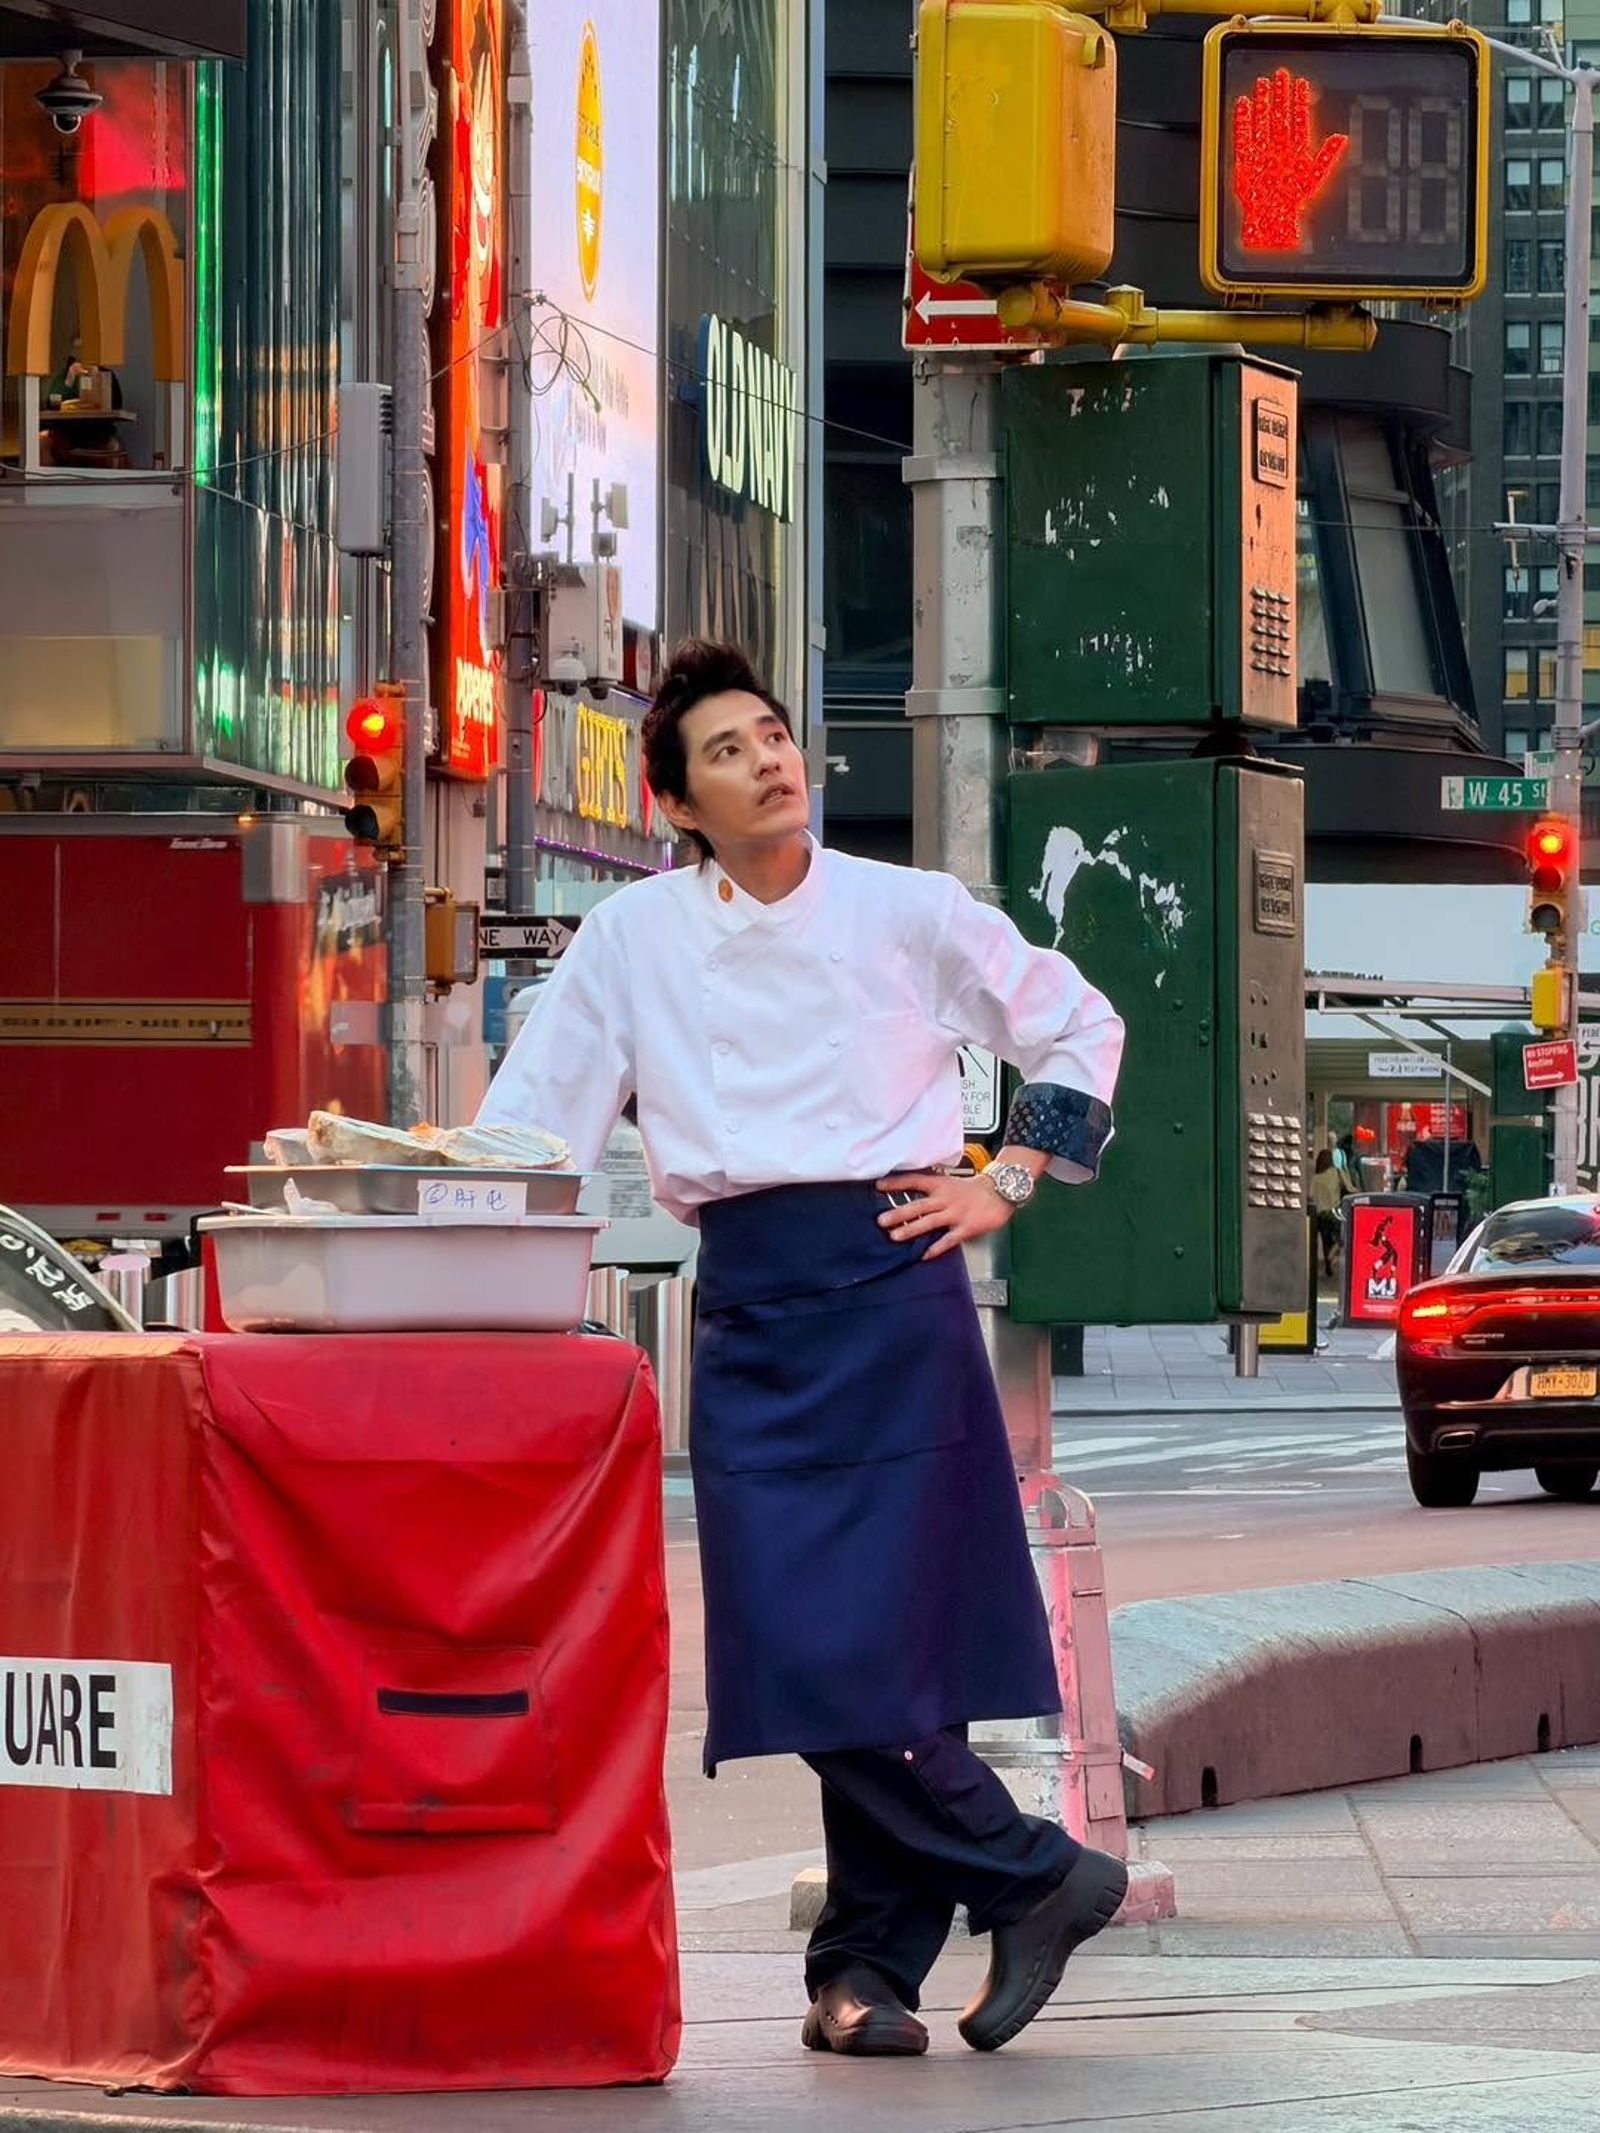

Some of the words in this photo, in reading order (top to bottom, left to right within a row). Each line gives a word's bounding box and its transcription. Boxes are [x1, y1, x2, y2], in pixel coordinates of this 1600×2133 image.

[707, 313, 746, 494] OLD
[748, 341, 798, 523] NAVY
[576, 702, 628, 829] GIFTS
[1469, 782, 1487, 806] W
[1498, 782, 1523, 806] 45
[480, 929, 500, 946] NE
[522, 929, 563, 945] WAY
[1537, 1045, 1569, 1058] STOPPING
[971, 1091, 991, 1102] FOR
[1368, 1277, 1397, 1297] MJ
